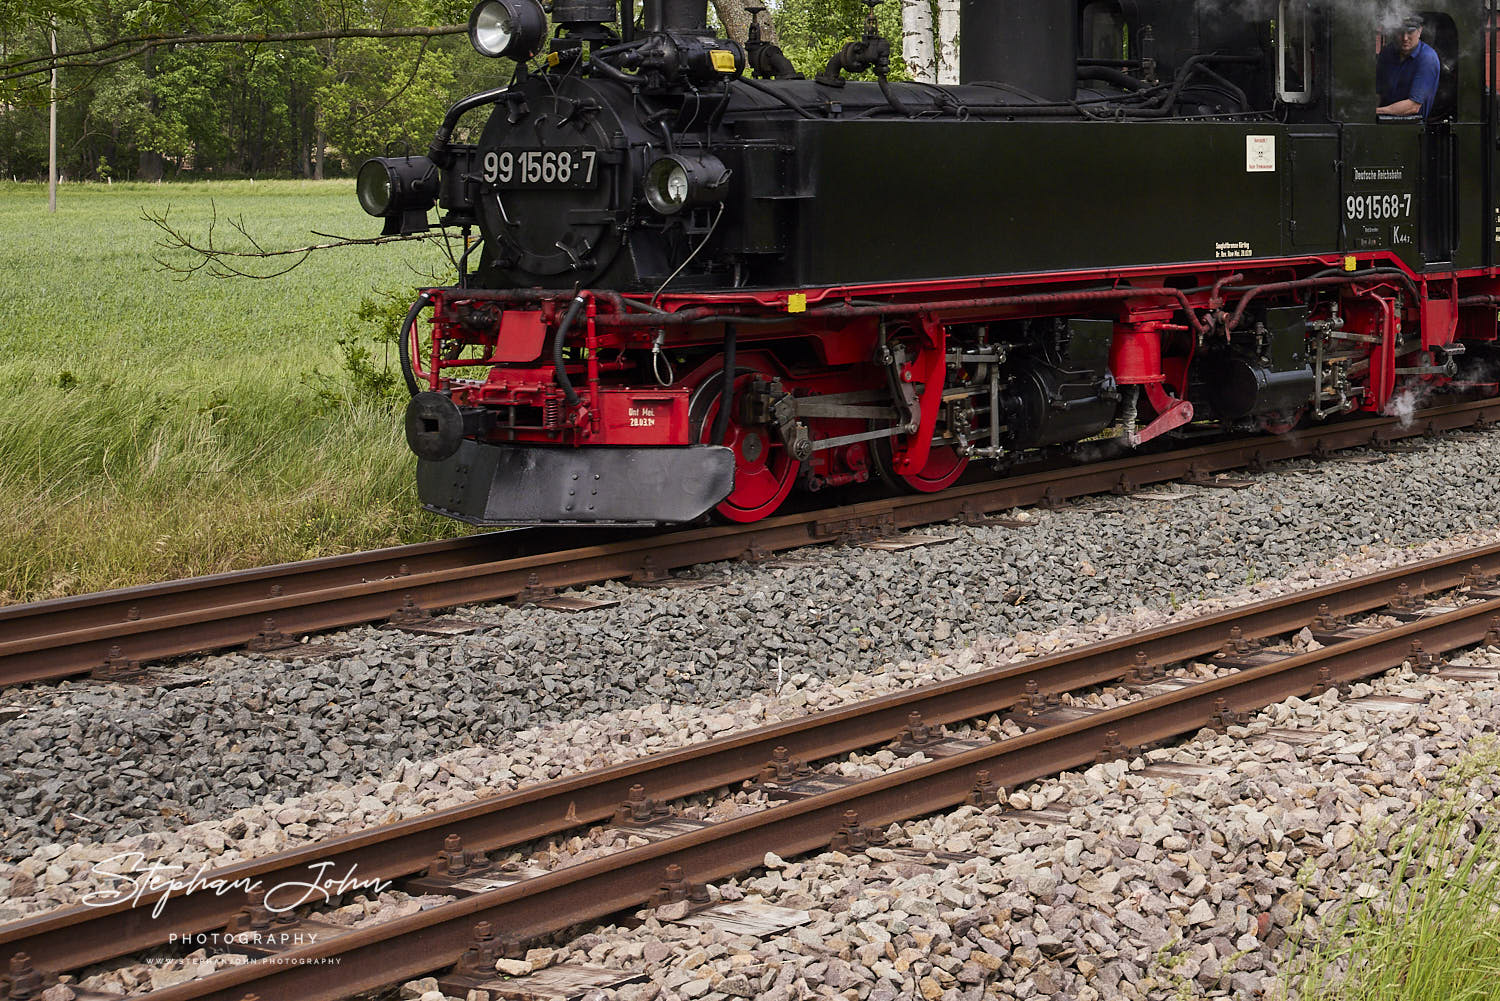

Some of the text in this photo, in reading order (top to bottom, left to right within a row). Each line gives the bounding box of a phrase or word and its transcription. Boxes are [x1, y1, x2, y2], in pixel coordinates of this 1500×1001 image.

[484, 151, 596, 183] 99 1568-7
[1354, 169, 1403, 180] Deutsche Reichsbahn
